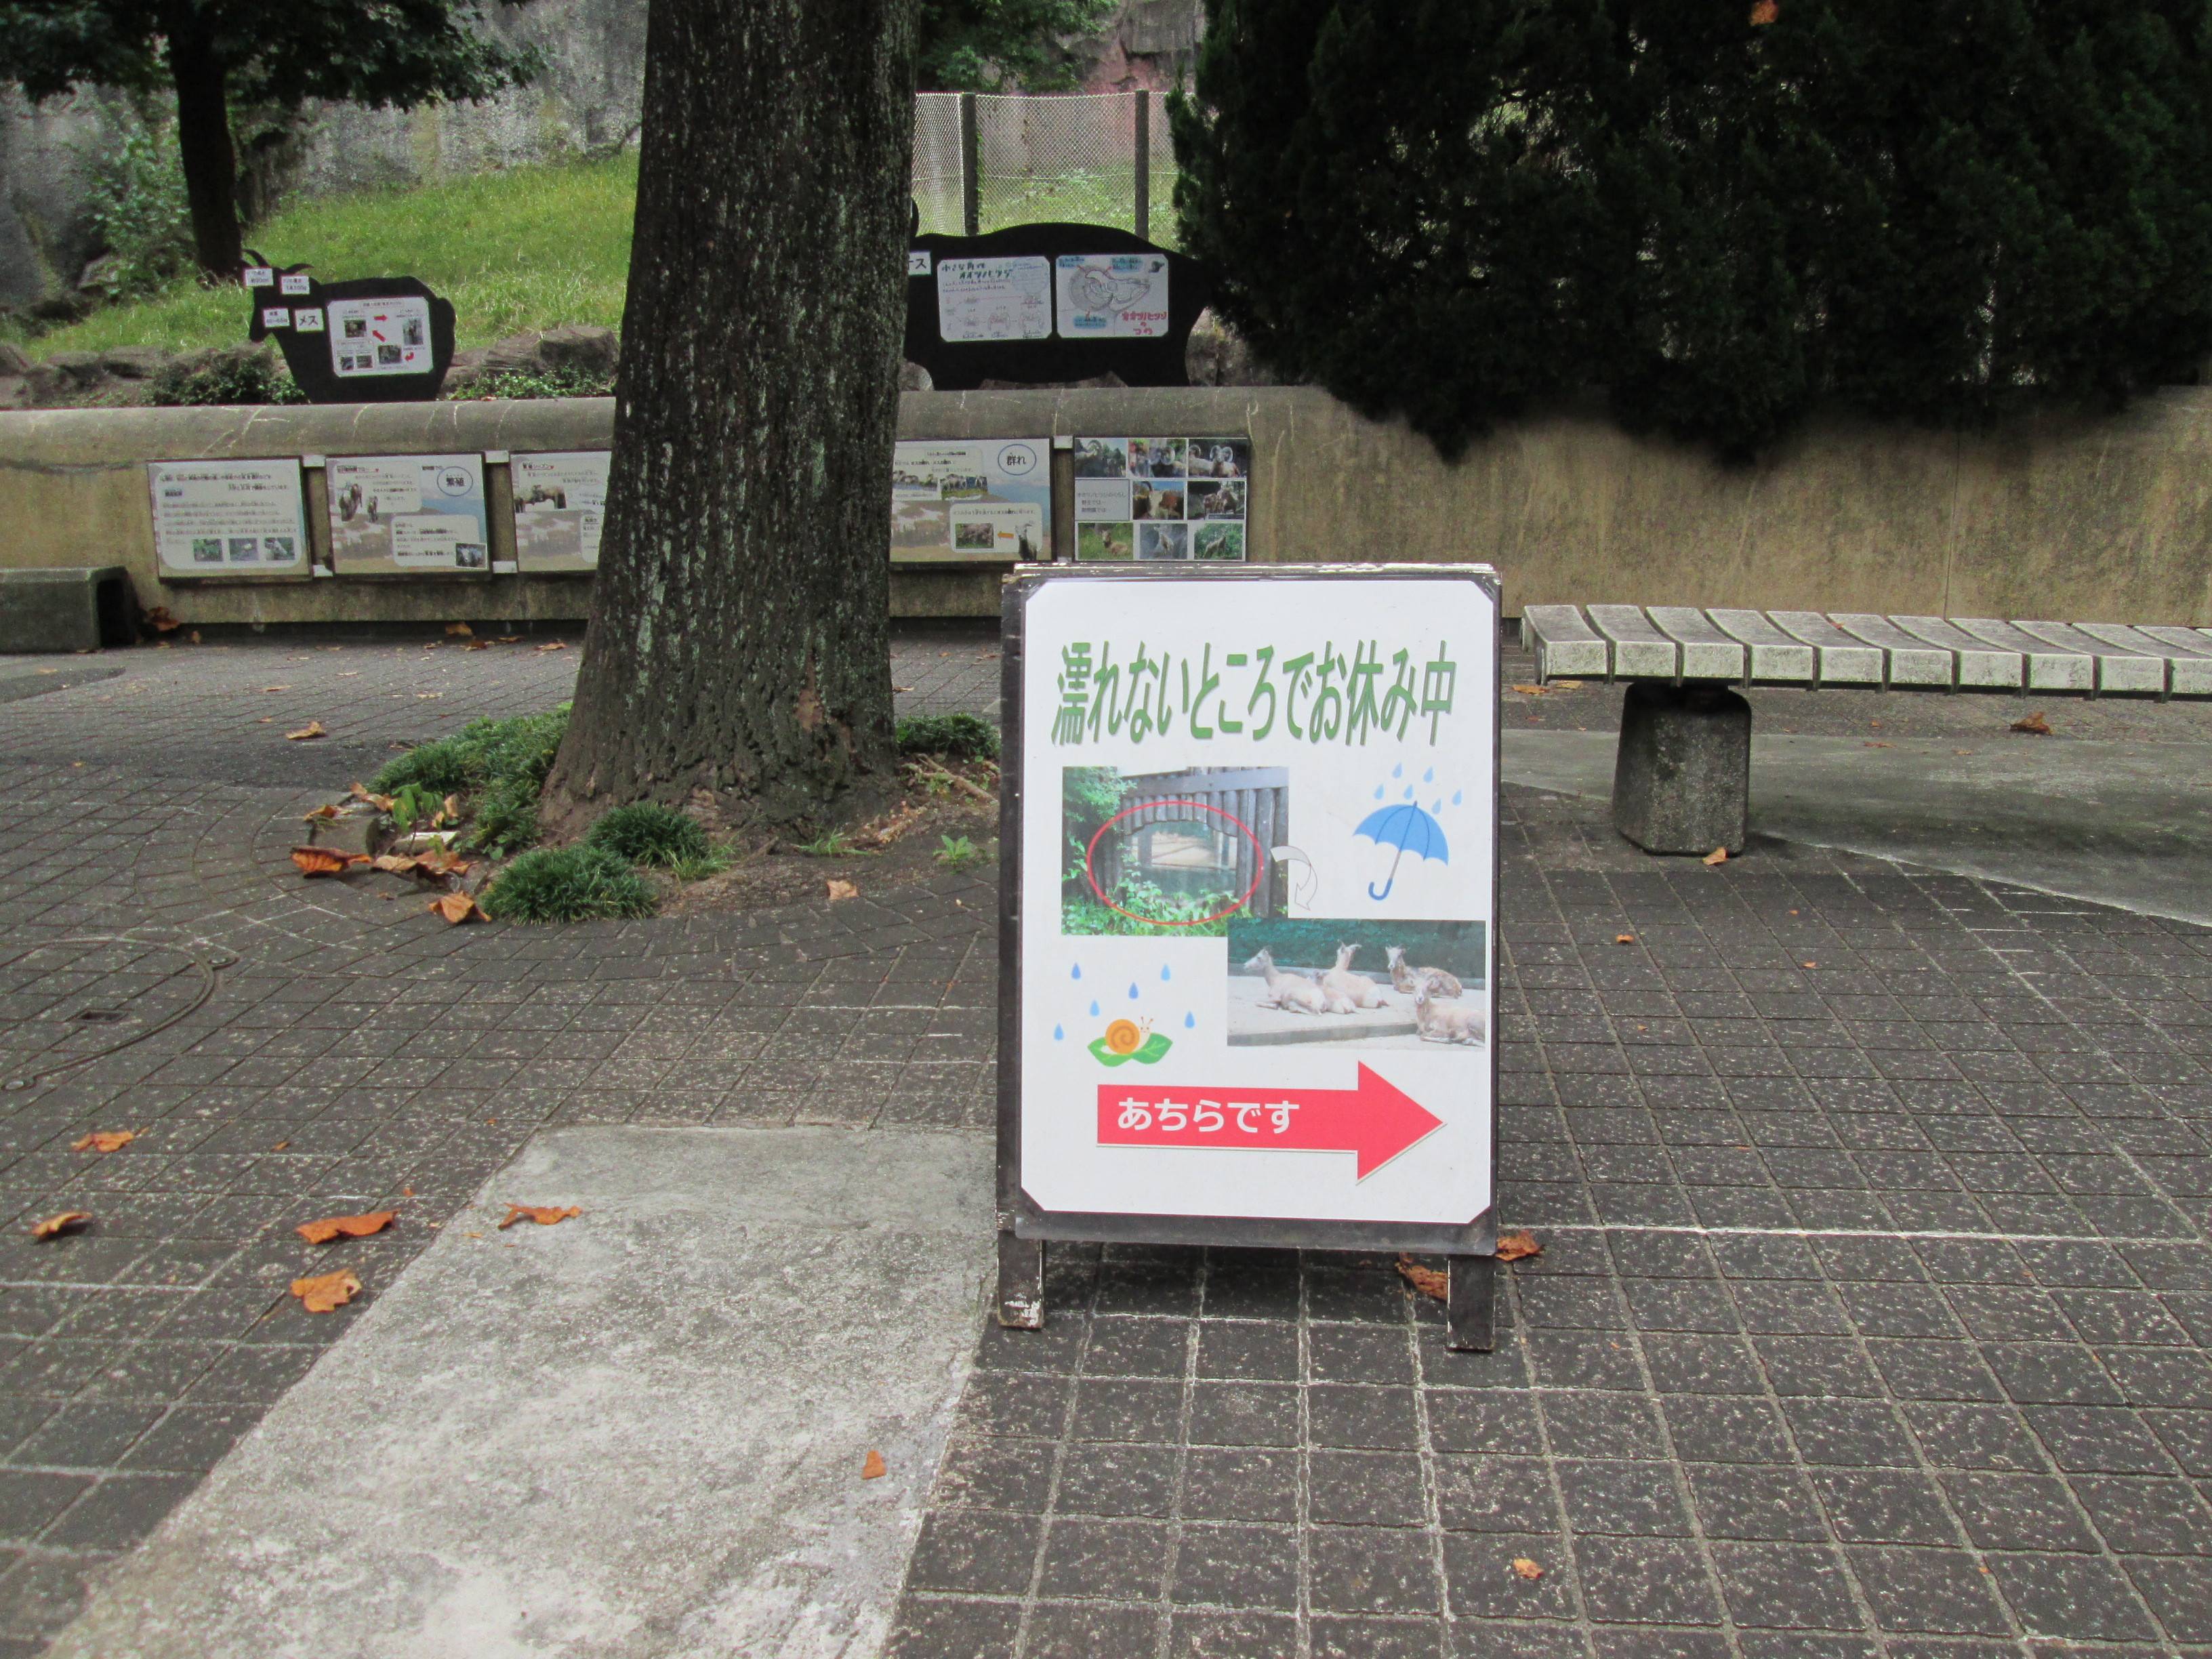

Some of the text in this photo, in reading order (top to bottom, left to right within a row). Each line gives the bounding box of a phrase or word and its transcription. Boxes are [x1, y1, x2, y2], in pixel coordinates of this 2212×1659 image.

[300, 315, 319, 326] メス
[1006, 455, 1027, 466] 群れ
[1051, 640, 1456, 746] 濡れないところでお休み中
[1117, 1096, 1300, 1134] あちらです
